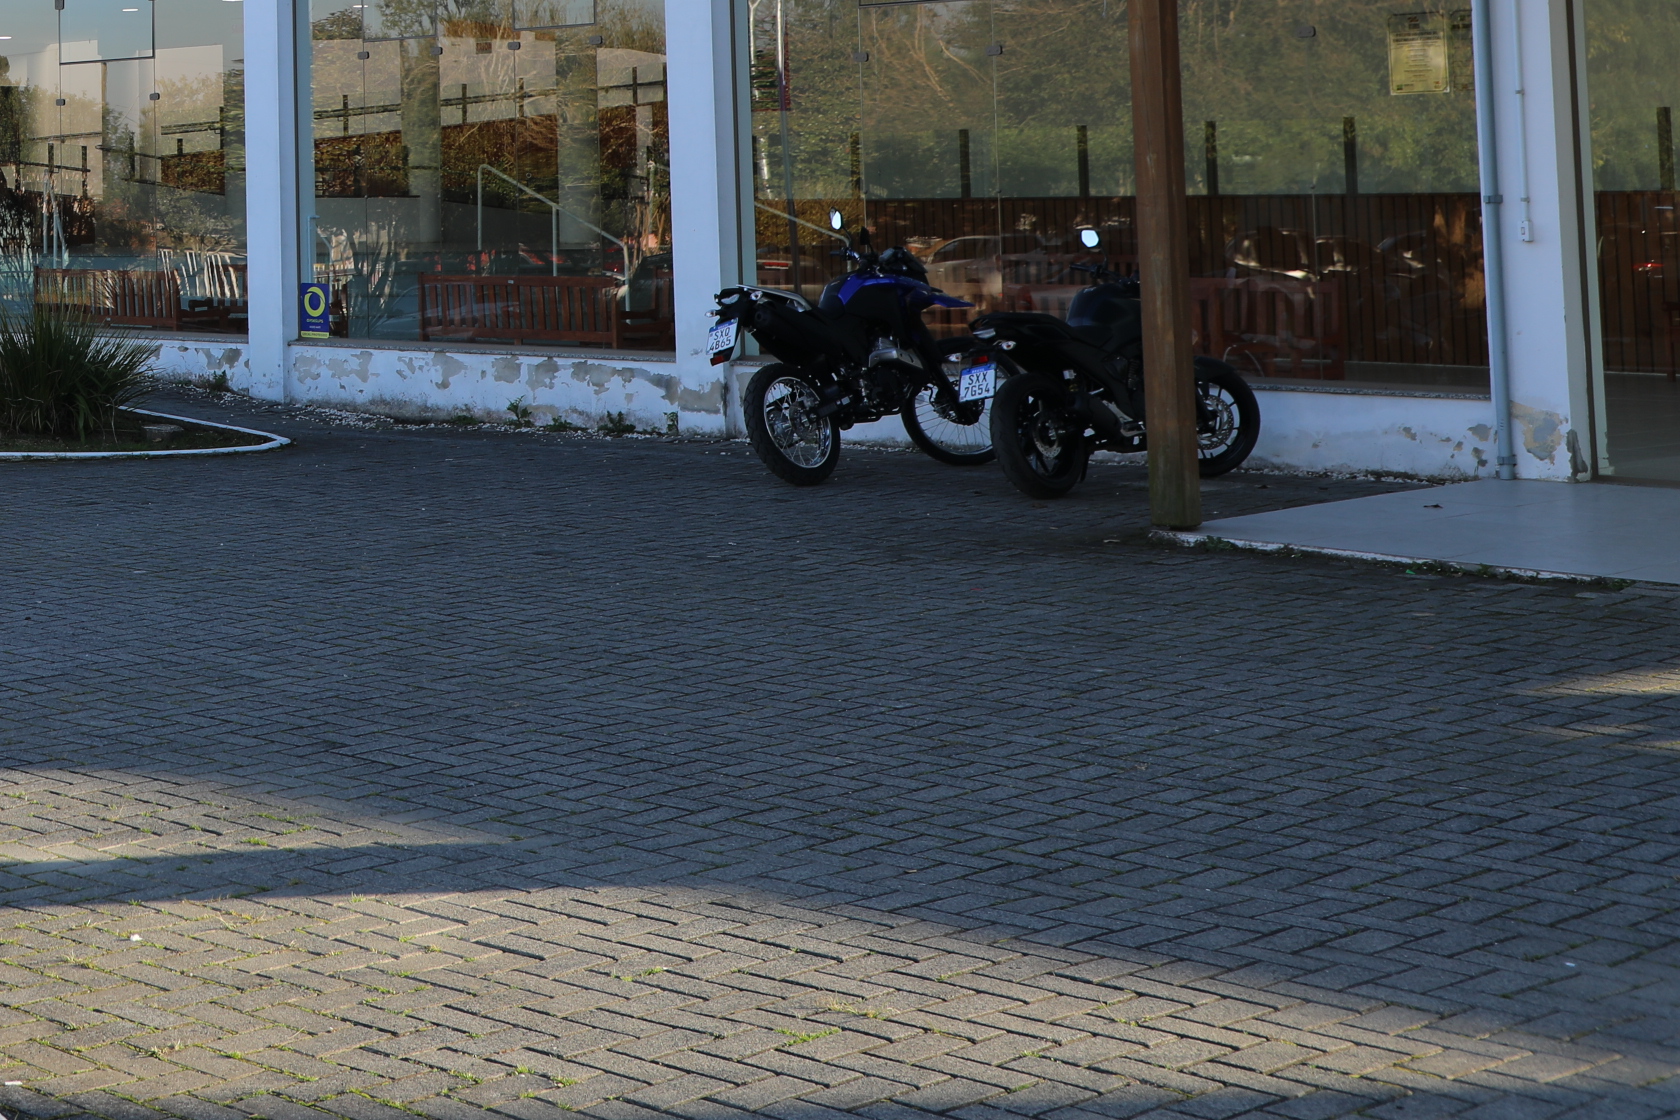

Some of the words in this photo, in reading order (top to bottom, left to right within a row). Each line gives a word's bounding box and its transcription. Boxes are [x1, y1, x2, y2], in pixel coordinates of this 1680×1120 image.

[709, 335, 731, 351] 4B65
[968, 371, 988, 385] SXX
[964, 383, 990, 398] 7G54
